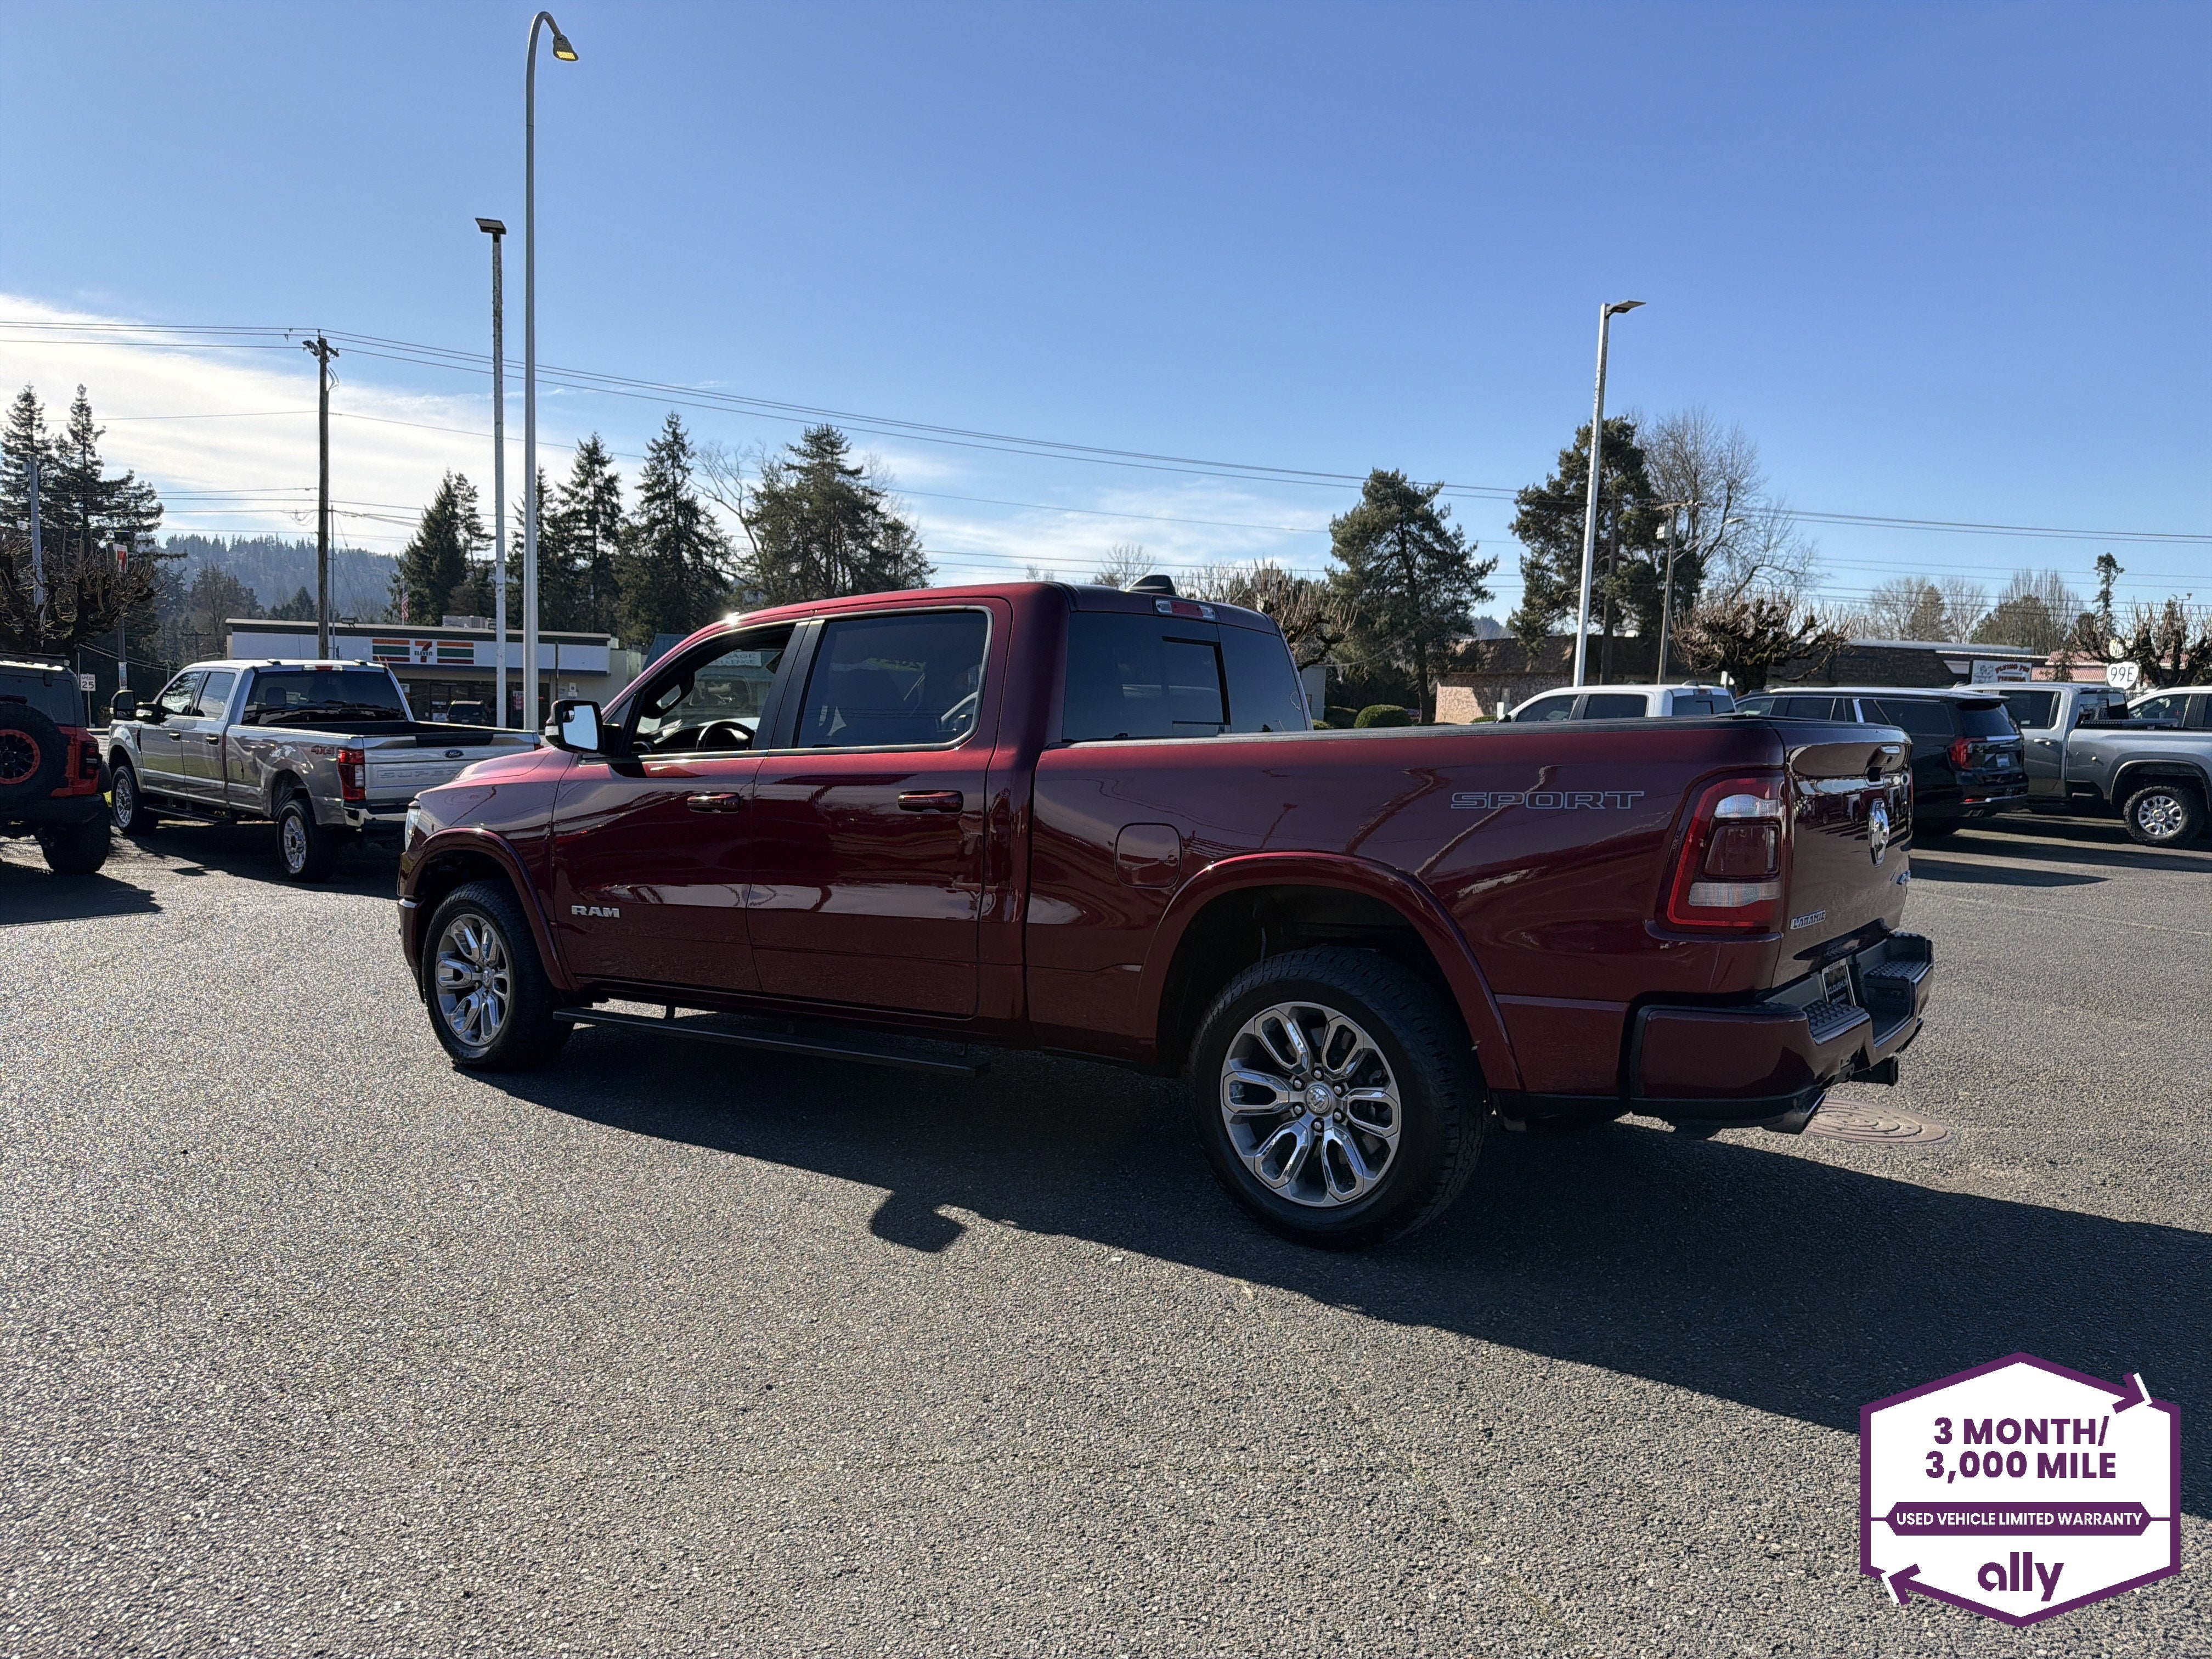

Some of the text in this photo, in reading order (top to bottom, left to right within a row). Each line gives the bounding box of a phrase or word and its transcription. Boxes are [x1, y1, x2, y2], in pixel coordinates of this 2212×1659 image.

[415, 640, 432, 663] 7
[2111, 666, 2134, 681] 99E
[82, 681, 94, 689] 25
[1451, 791, 1645, 809] SPORT
[571, 905, 620, 918] RAM
